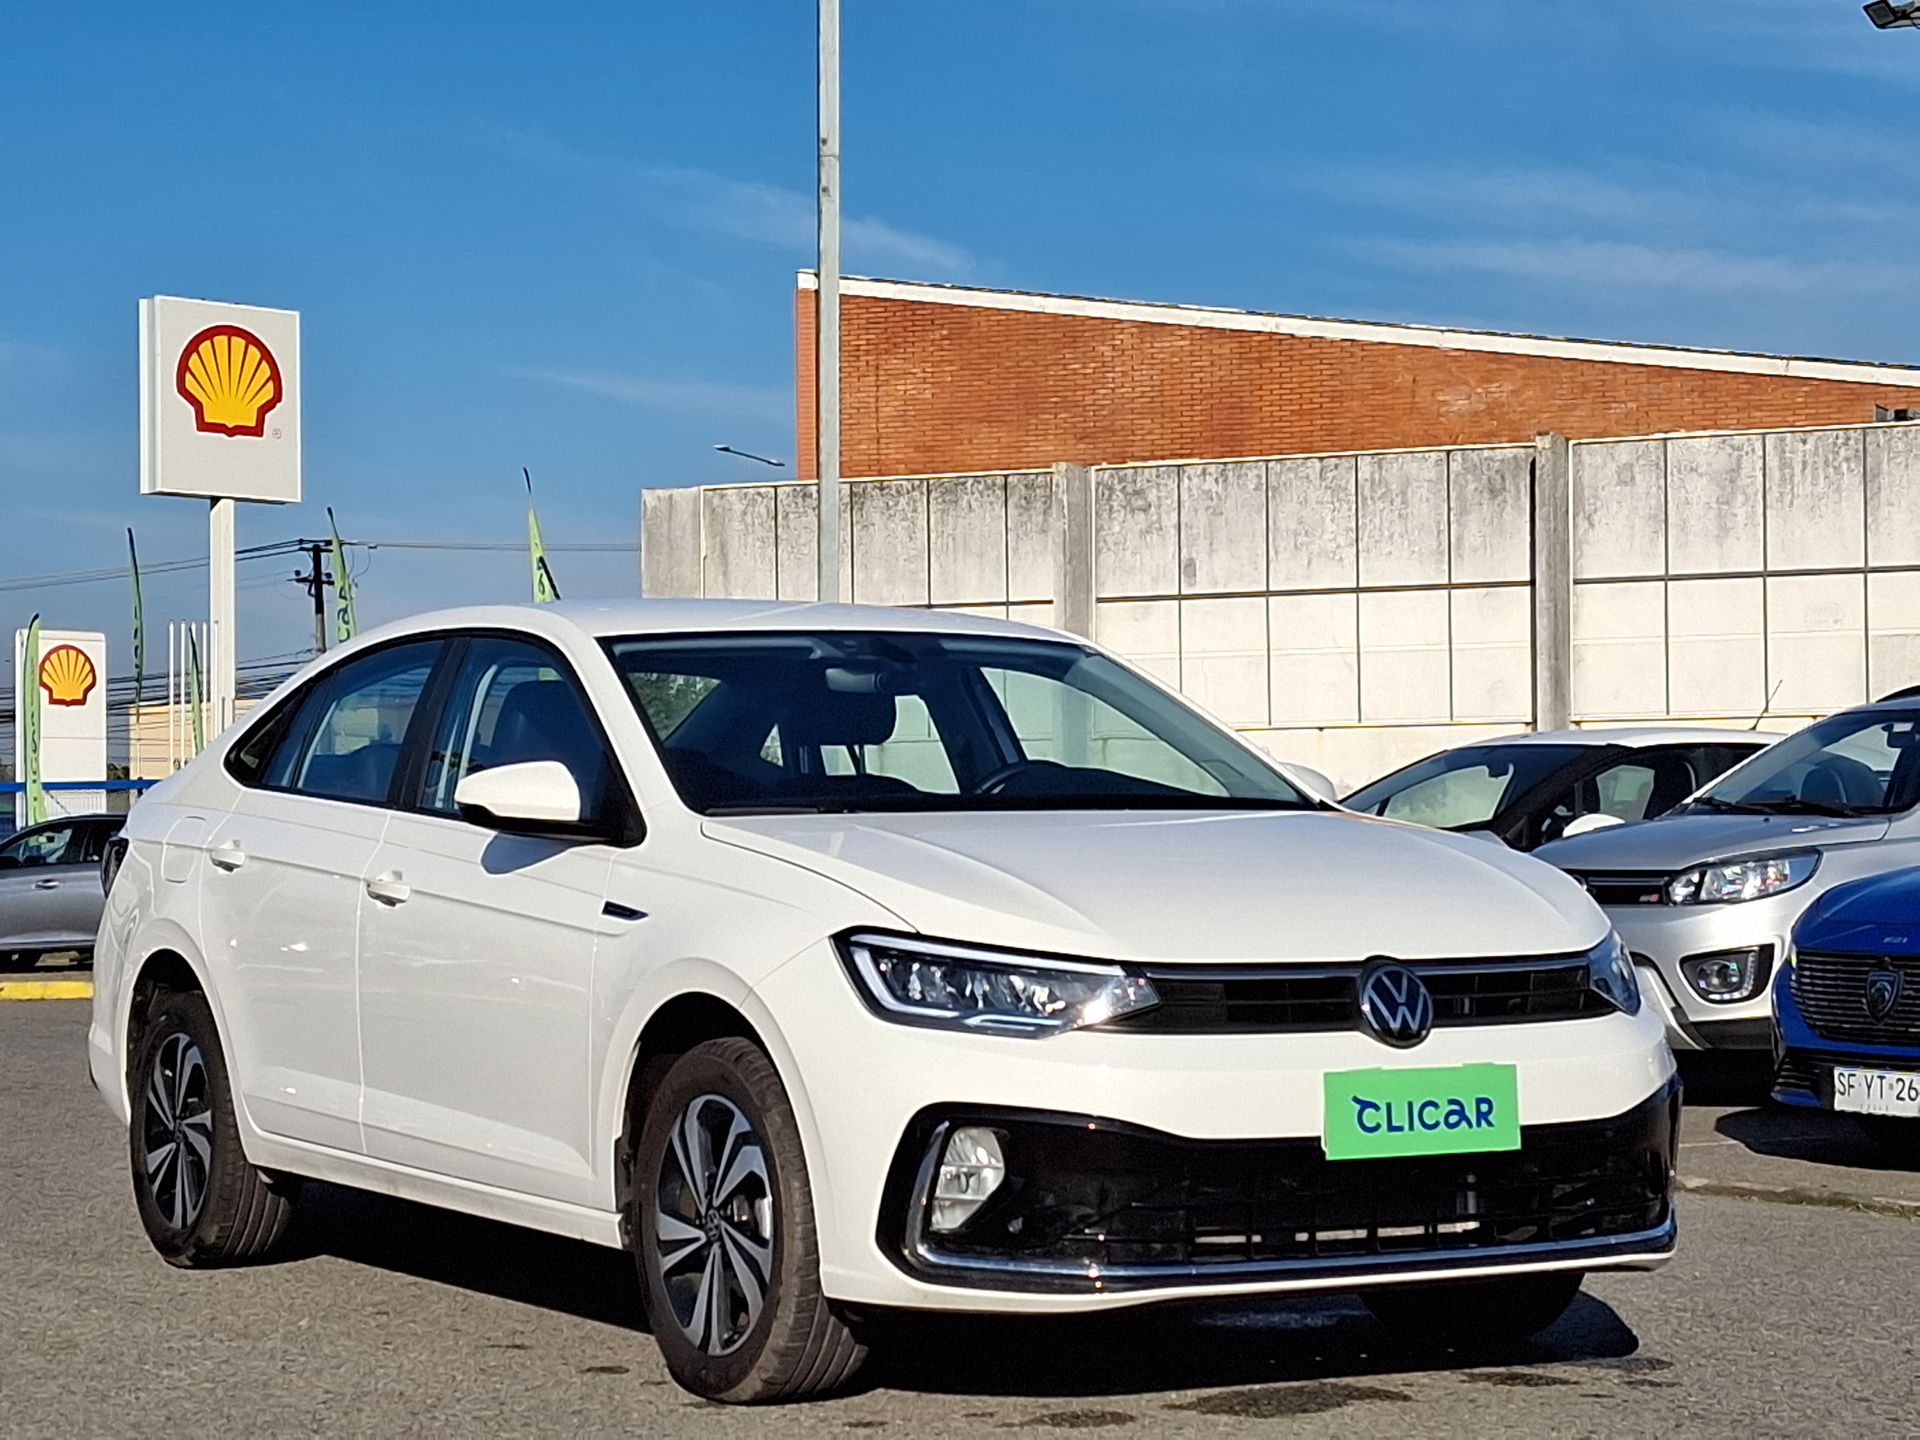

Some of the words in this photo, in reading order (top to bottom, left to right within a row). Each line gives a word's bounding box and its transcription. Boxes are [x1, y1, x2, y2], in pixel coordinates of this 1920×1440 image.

[1837, 1071, 1857, 1097] SF
[1864, 1074, 1887, 1100] YT
[1895, 1077, 1919, 1102] 26
